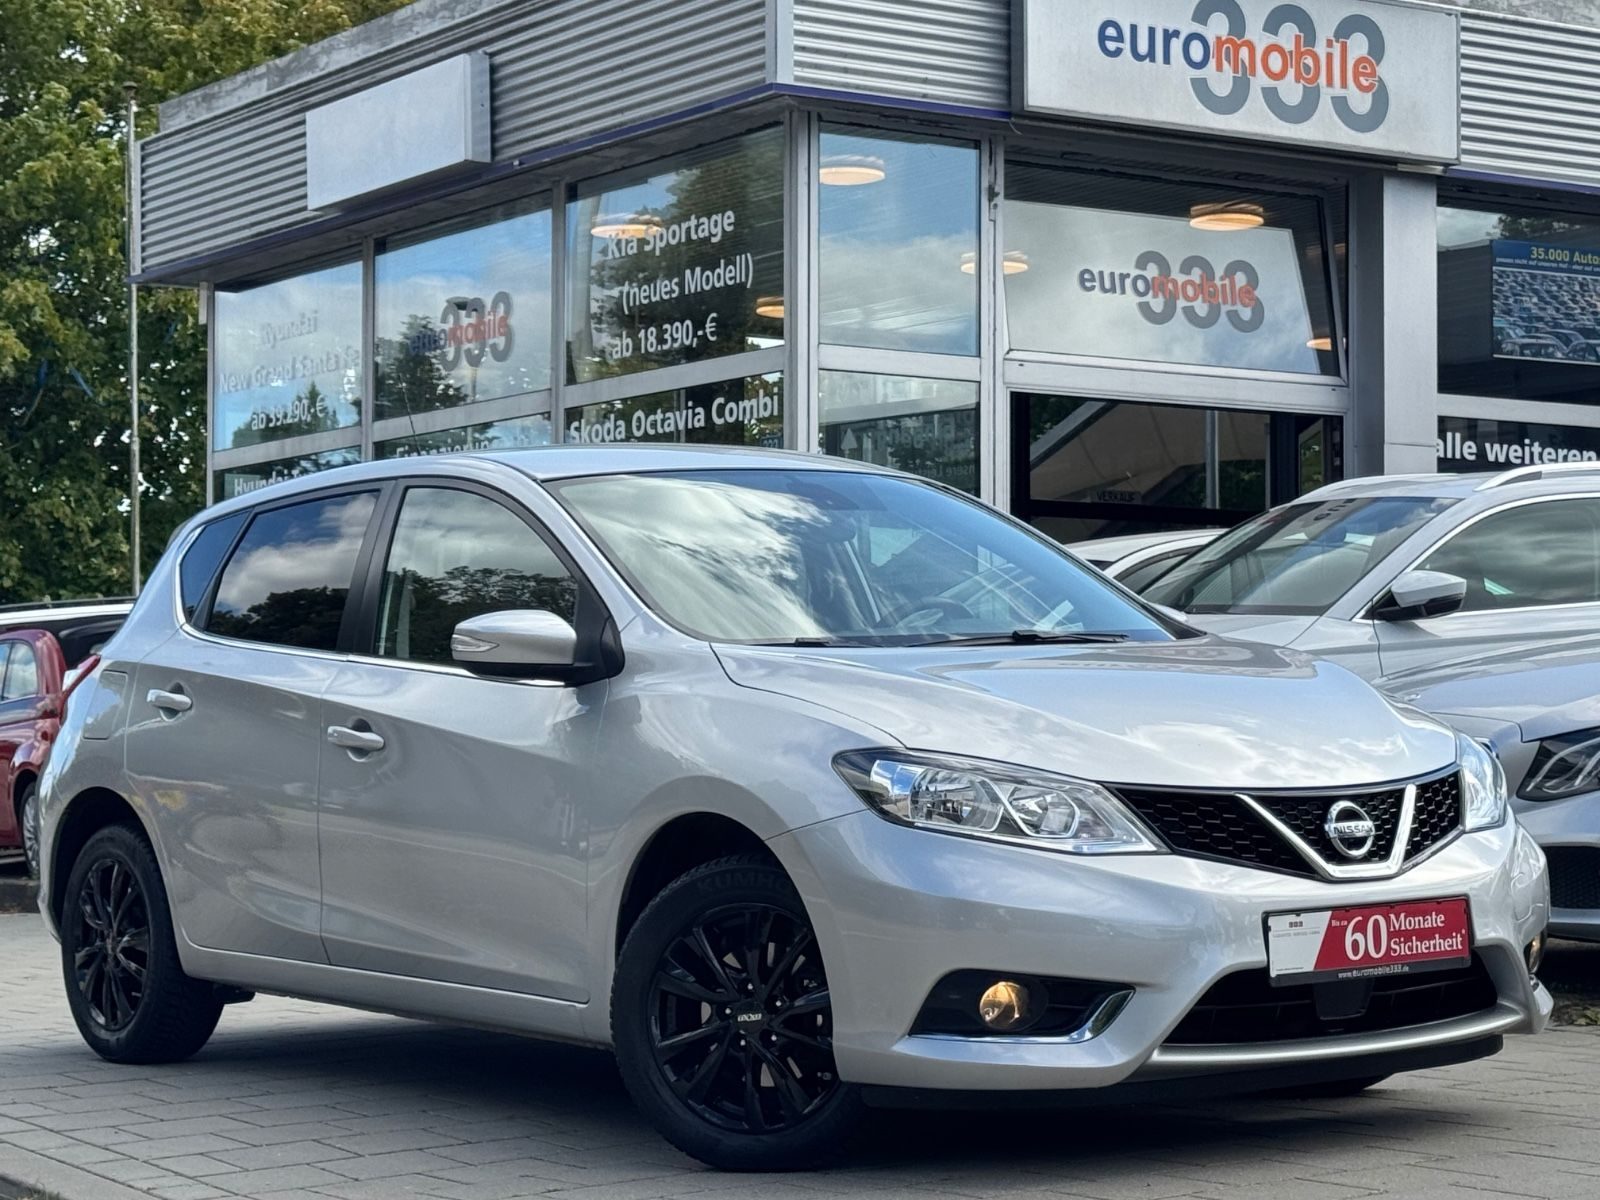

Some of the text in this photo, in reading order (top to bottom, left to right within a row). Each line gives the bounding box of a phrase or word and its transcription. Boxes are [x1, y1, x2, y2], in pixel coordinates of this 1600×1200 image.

[1097, 19, 1378, 93] euromobile
[1189, 0, 1390, 133] 333
[644, 210, 735, 256] Sportage
[1530, 246, 1570, 261] 35.000
[622, 252, 753, 315] (neues Modell)
[1078, 267, 1257, 308] euromobile
[1134, 250, 1265, 333] 333
[612, 331, 632, 360] ab
[251, 411, 266, 430] ab
[569, 414, 626, 443] Skoda
[632, 400, 705, 437] Octavia
[712, 387, 778, 425] Combi
[1437, 432, 1597, 464] alle weiteren
[1333, 823, 1373, 835] NISSAN
[1345, 914, 1388, 961] 60
[1389, 911, 1445, 931] Monate
